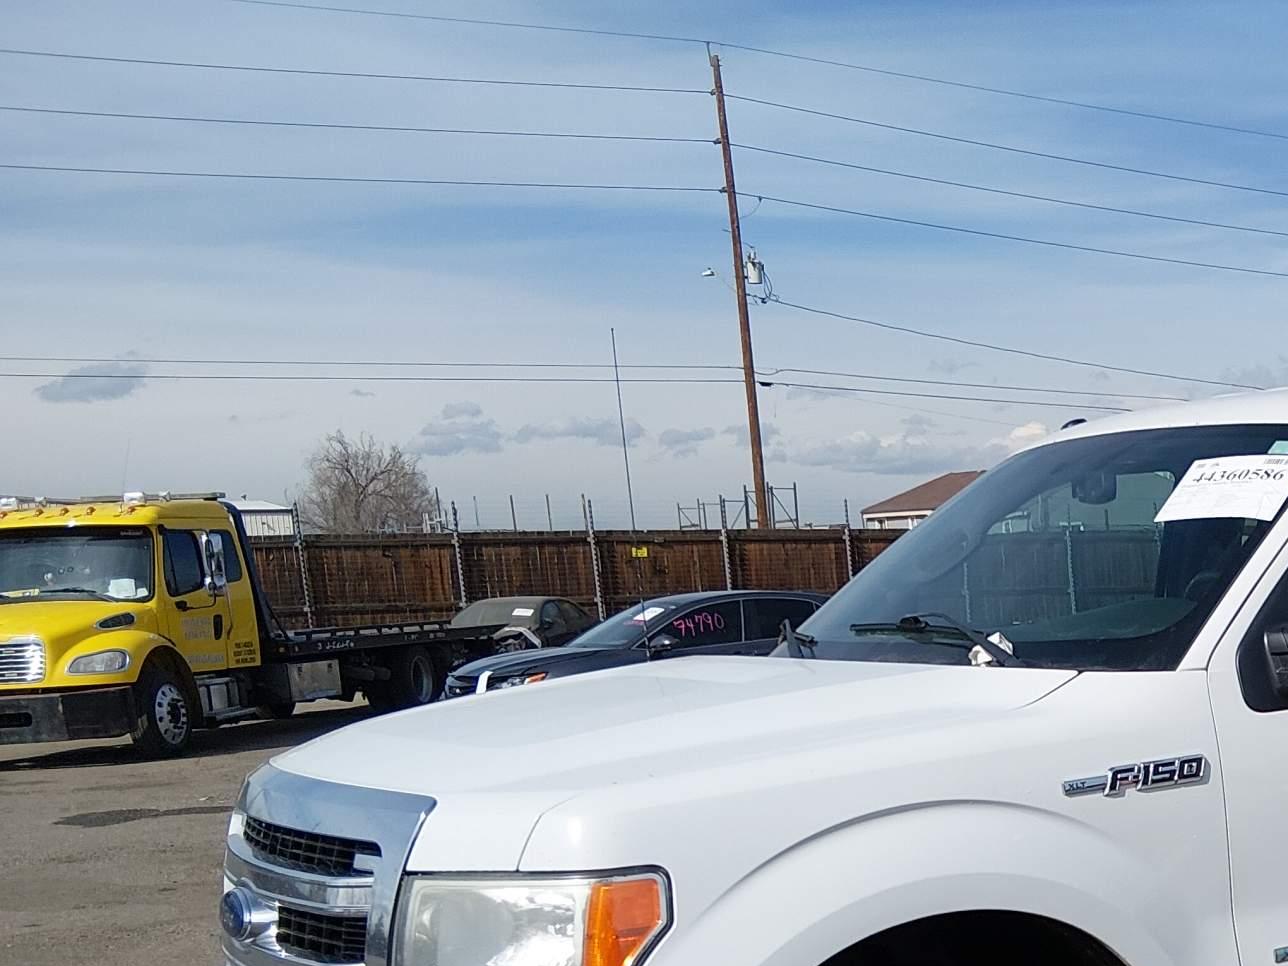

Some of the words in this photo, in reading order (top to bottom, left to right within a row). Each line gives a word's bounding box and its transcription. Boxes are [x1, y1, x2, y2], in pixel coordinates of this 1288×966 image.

[1192, 468, 1287, 483] 44360586
[672, 612, 725, 637] 74790
[1067, 782, 1088, 791] XLT
[1104, 755, 1208, 797] F-150
